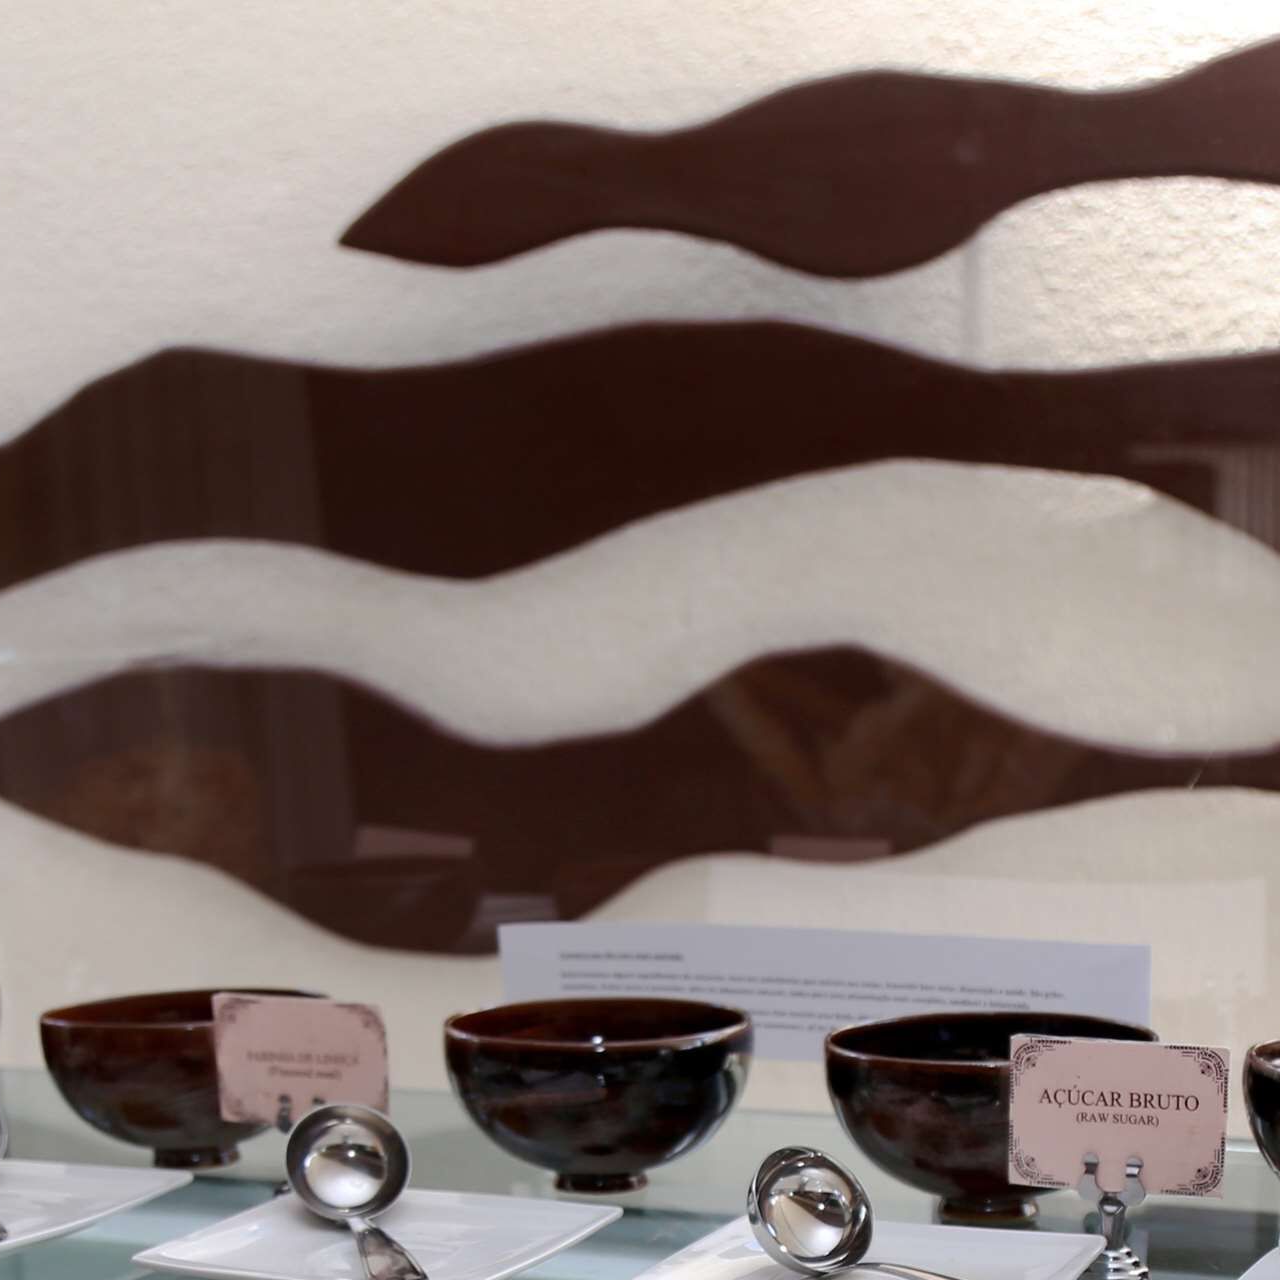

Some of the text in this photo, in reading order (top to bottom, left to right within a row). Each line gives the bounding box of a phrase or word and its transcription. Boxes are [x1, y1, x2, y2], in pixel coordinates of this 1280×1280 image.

[1039, 1084, 1200, 1112] AÇÚCAR BRUTO
[1076, 1111, 1160, 1128] (RAW SUGAR)
